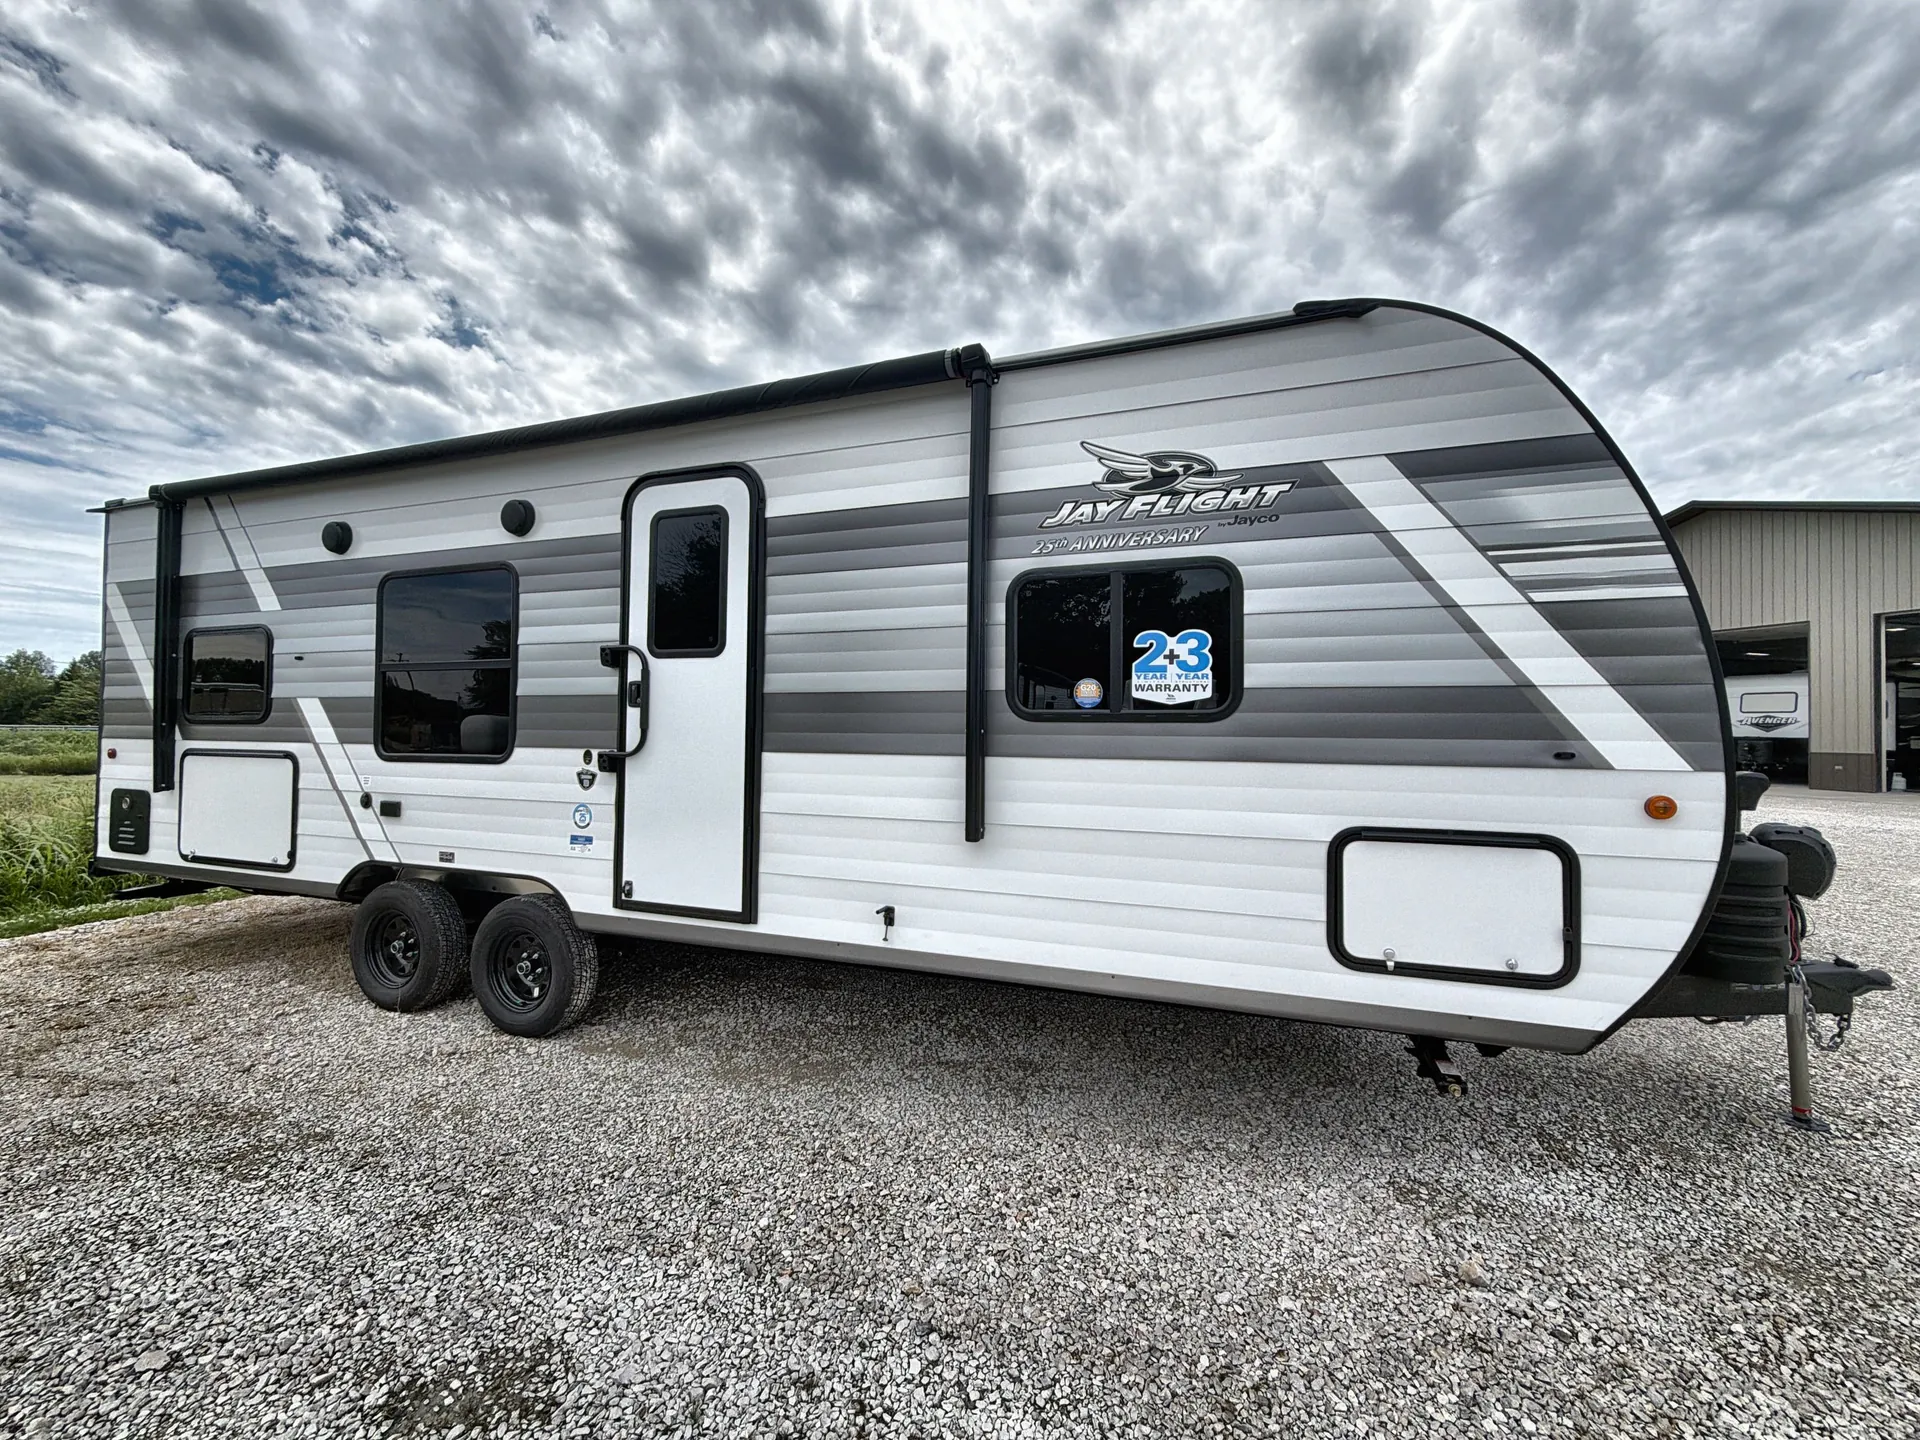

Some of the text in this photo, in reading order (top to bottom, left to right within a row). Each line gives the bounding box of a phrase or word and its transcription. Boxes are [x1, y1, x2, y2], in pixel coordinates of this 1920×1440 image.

[1042, 481, 1296, 527] JAY FLIGHT
[1227, 514, 1280, 527] Jayco
[1031, 525, 1210, 555] 25th ANNIVERSARY
[1135, 684, 1209, 692] WARRANTY
[1741, 717, 1798, 725] AVENGER
